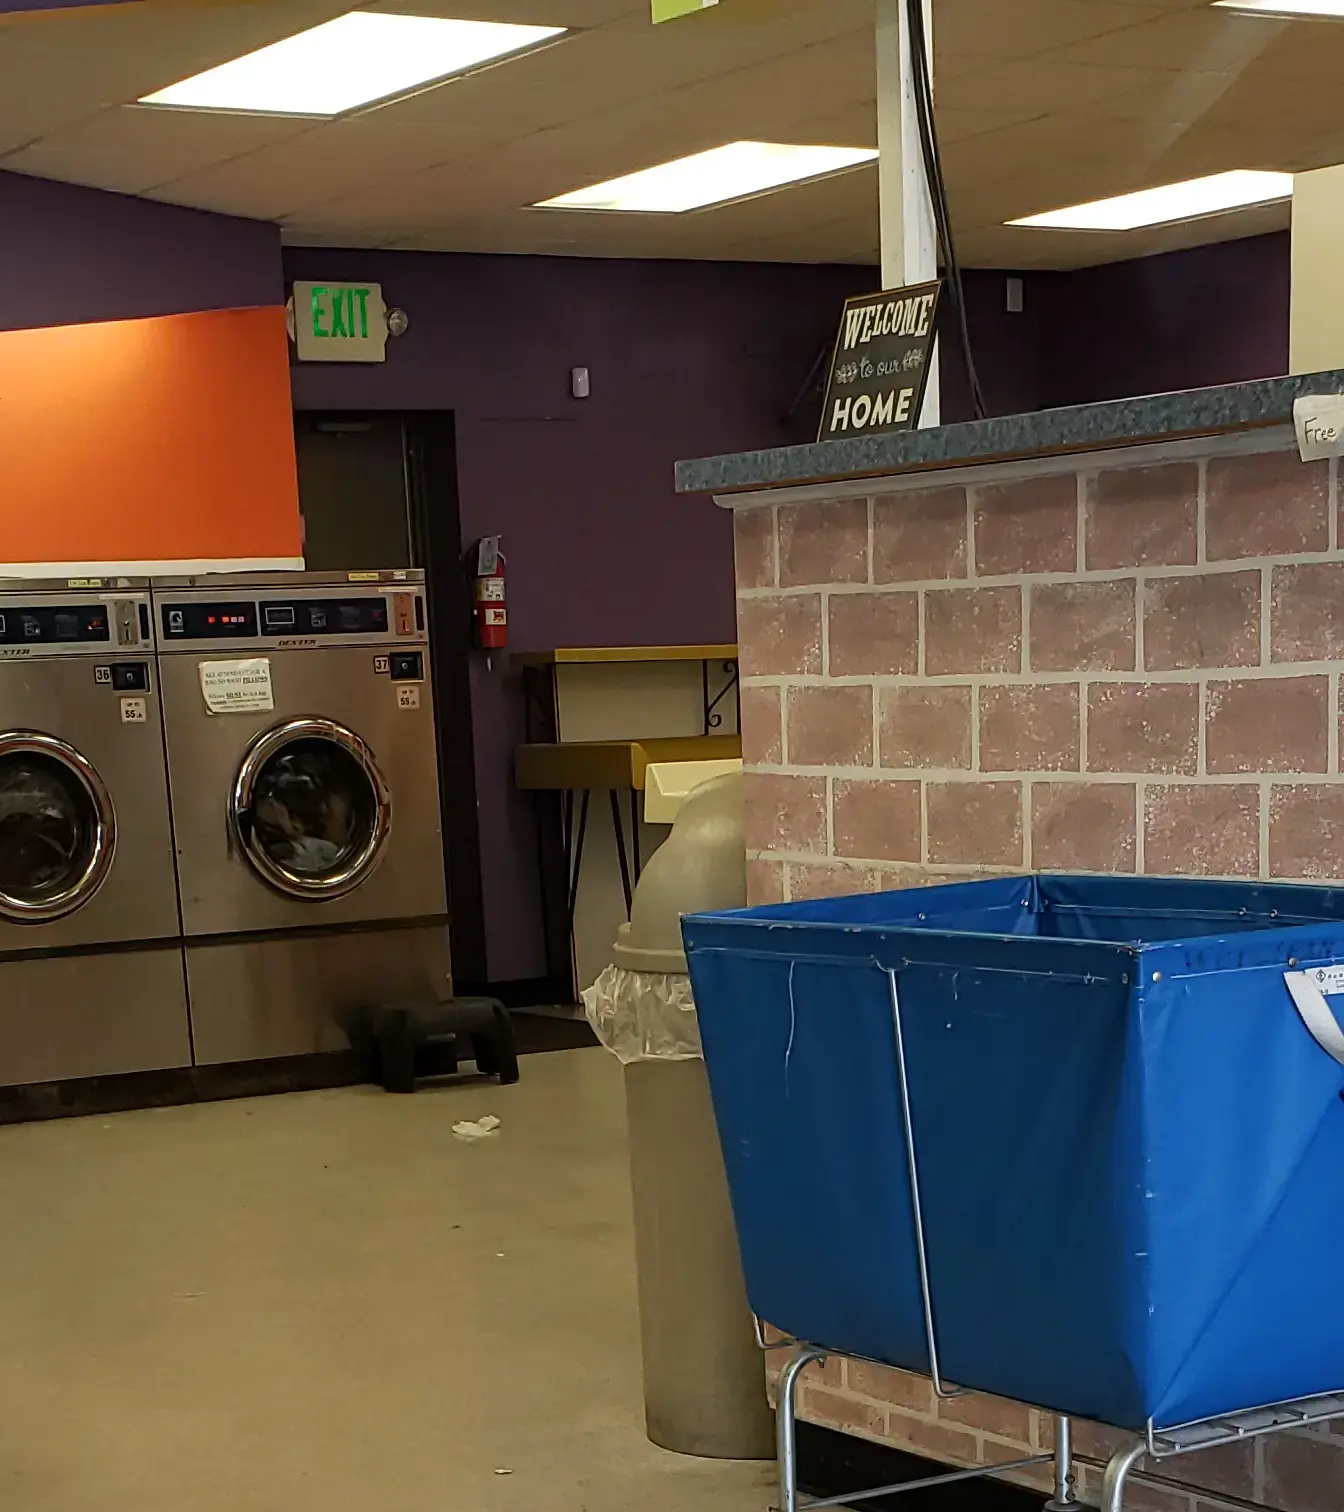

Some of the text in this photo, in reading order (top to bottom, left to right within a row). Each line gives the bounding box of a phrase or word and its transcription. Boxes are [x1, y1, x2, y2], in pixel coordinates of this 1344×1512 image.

[311, 286, 370, 338] EXIT
[843, 293, 935, 350] WELCOME
[859, 355, 901, 379] to our
[830, 388, 914, 432] HOME
[1304, 416, 1337, 444] Free
[97, 669, 110, 680] 36
[375, 659, 388, 670] 37
